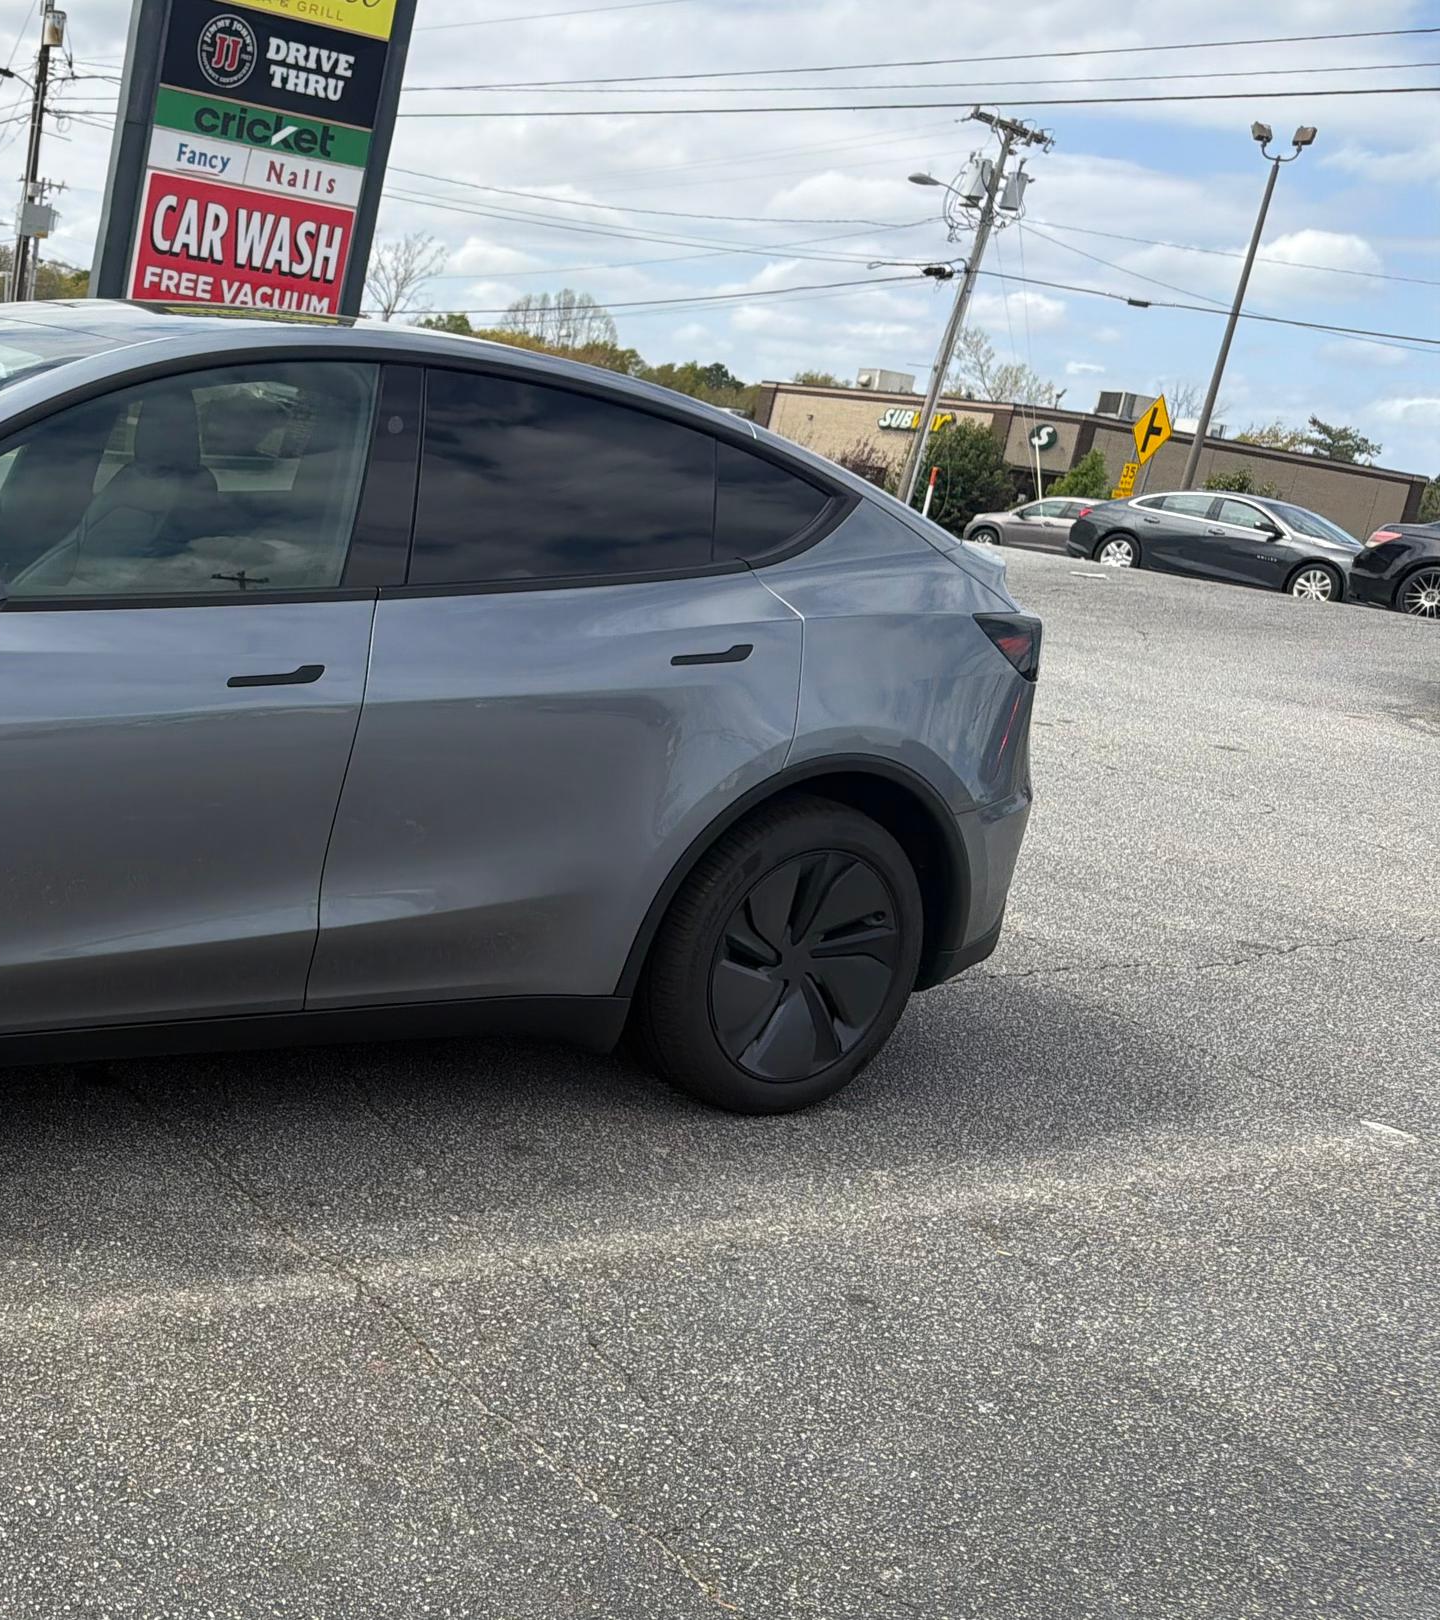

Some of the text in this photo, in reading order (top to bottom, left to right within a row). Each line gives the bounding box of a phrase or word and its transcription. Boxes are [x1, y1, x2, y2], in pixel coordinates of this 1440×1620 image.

[296, 1, 344, 21] GRILL
[203, 19, 231, 43] JIMMY
[211, 33, 243, 71] JJ
[266, 36, 355, 78] DRIVE
[269, 64, 345, 101] THRU
[194, 106, 335, 158] cricket
[176, 142, 231, 173] Fancy
[151, 194, 344, 284] CAR WASH
[143, 265, 330, 315] FREE VACUUM
[1122, 465, 1137, 479] 35
